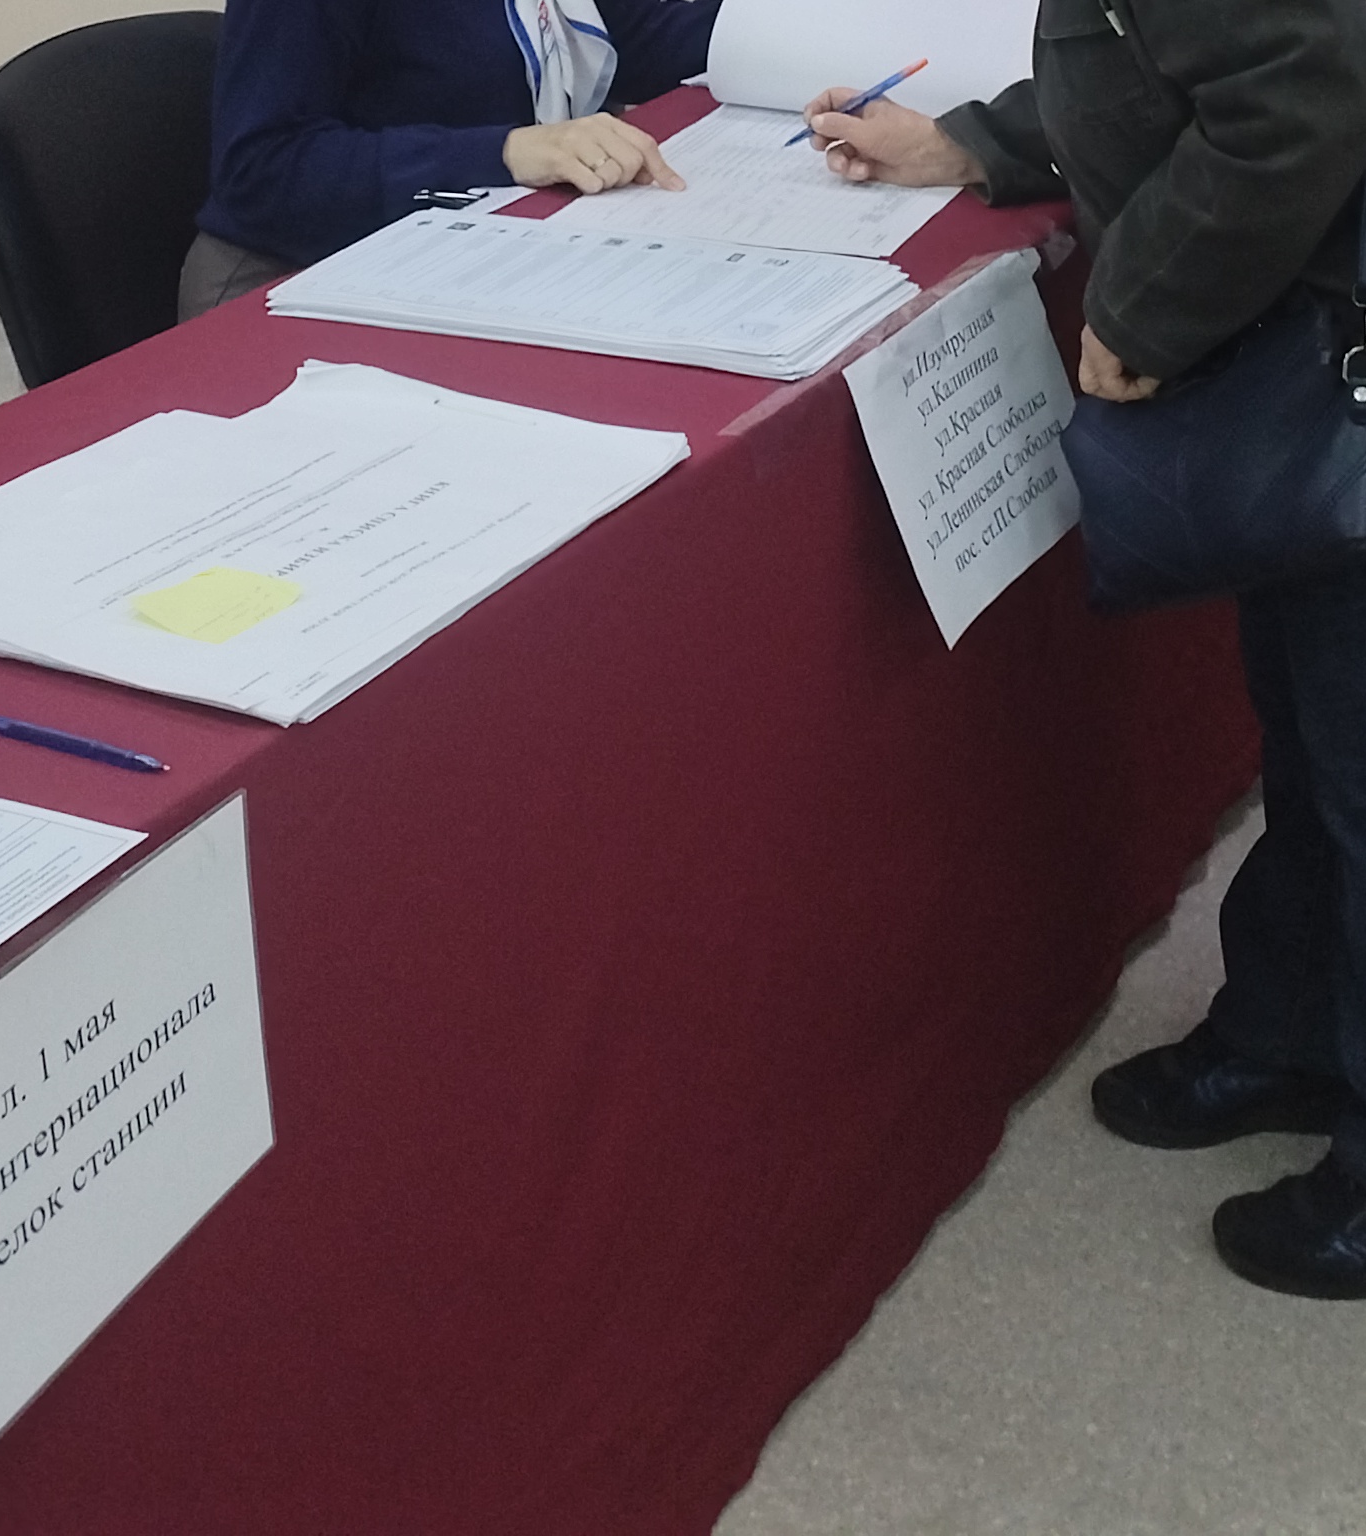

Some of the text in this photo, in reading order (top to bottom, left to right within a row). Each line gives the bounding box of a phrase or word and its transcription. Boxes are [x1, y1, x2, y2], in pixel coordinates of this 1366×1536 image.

[917, 345, 999, 426] ул.Калинина
[934, 383, 1003, 457] ул.Красная
[918, 390, 1047, 520] ул. Красная Слободка
[926, 418, 1064, 560] ул.Ленинская Слободка
[955, 541, 982, 573] пос.
[37, 1047, 51, 1083] 1
[63, 998, 117, 1063] мая
[71, 1070, 188, 1193] станции
